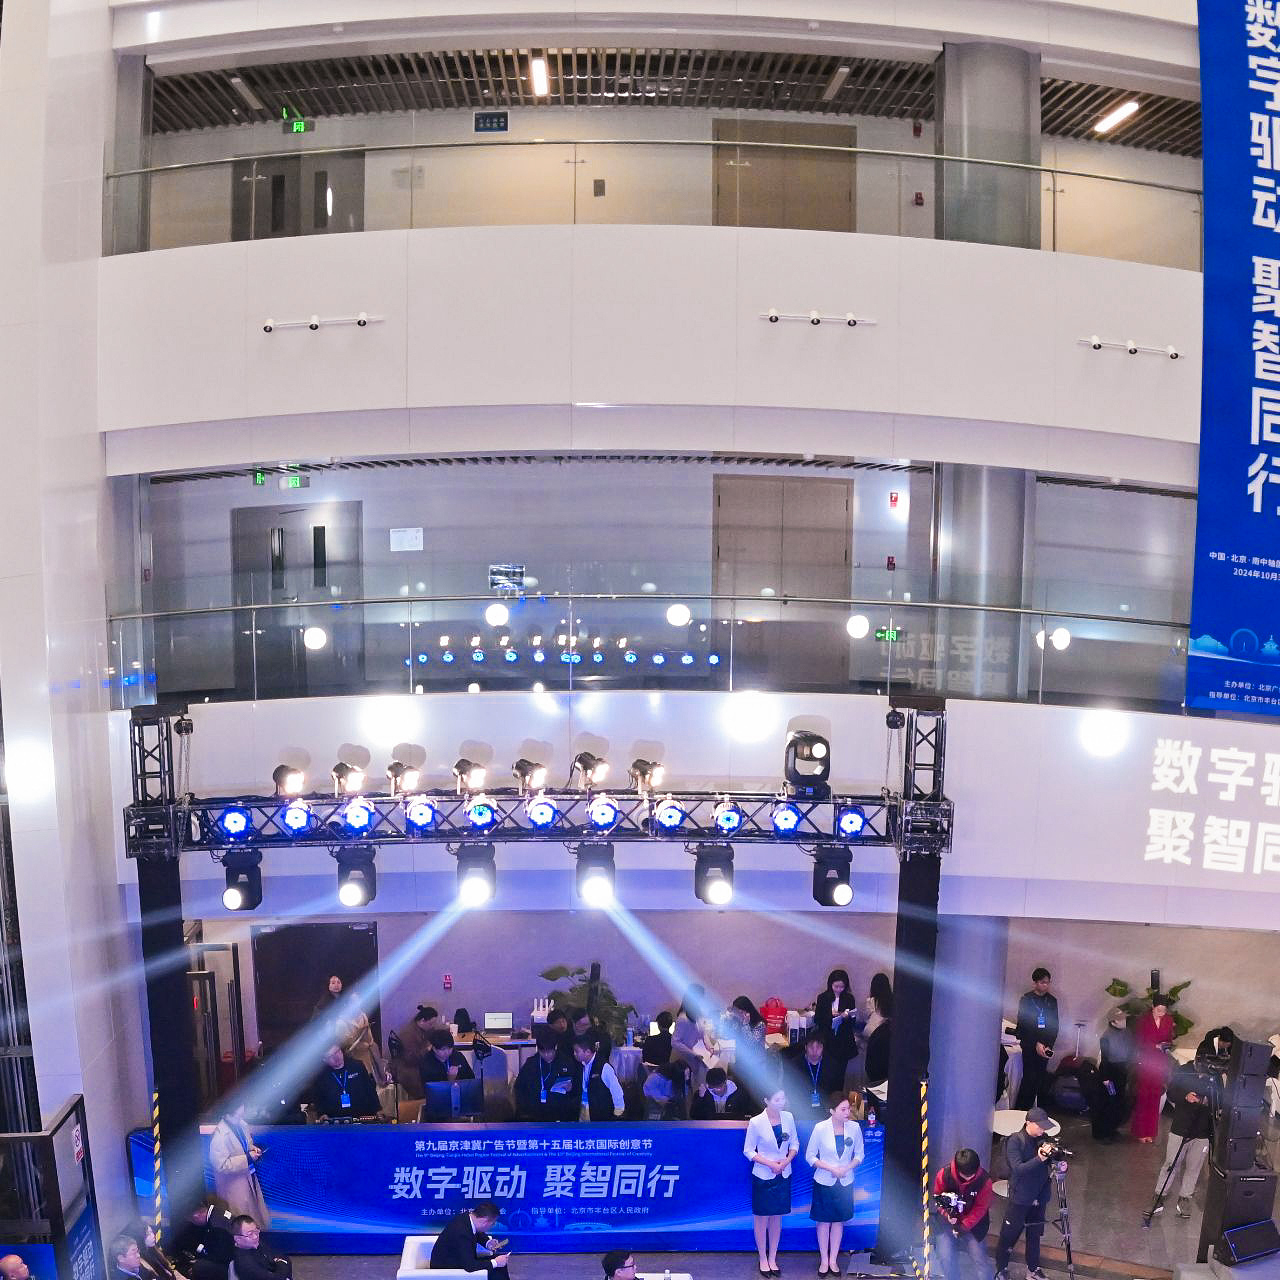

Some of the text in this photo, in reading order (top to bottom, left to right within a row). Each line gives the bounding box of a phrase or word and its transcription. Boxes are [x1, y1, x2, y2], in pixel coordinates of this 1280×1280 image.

[414, 1138, 653, 1152] 第九届京津冀广告节暨第十五届北京国际创意节
[388, 1160, 680, 1200] 数字驱动 聚智同行
